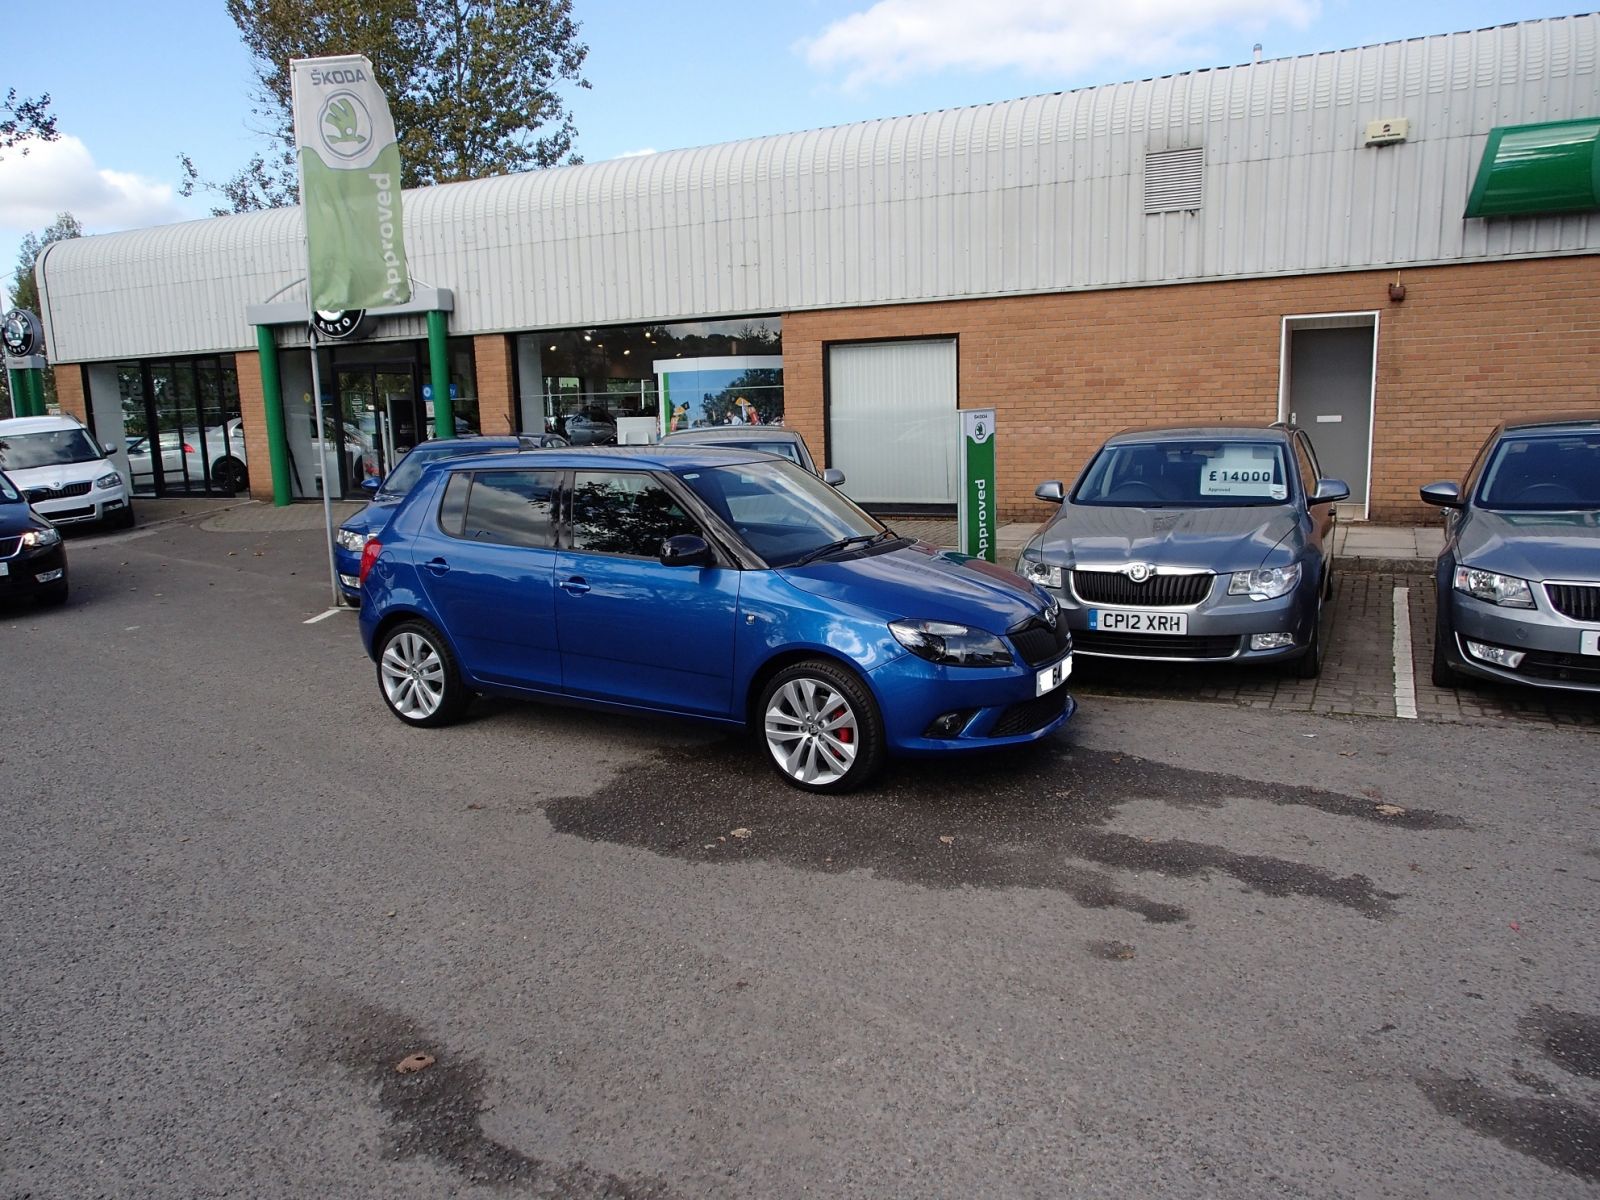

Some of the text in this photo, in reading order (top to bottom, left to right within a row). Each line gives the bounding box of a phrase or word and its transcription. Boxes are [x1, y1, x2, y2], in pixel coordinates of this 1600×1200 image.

[368, 173, 404, 304] Approved
[319, 317, 351, 332] AUTO
[975, 479, 989, 561] Approved
[1103, 613, 1180, 632] CP12 XRH
